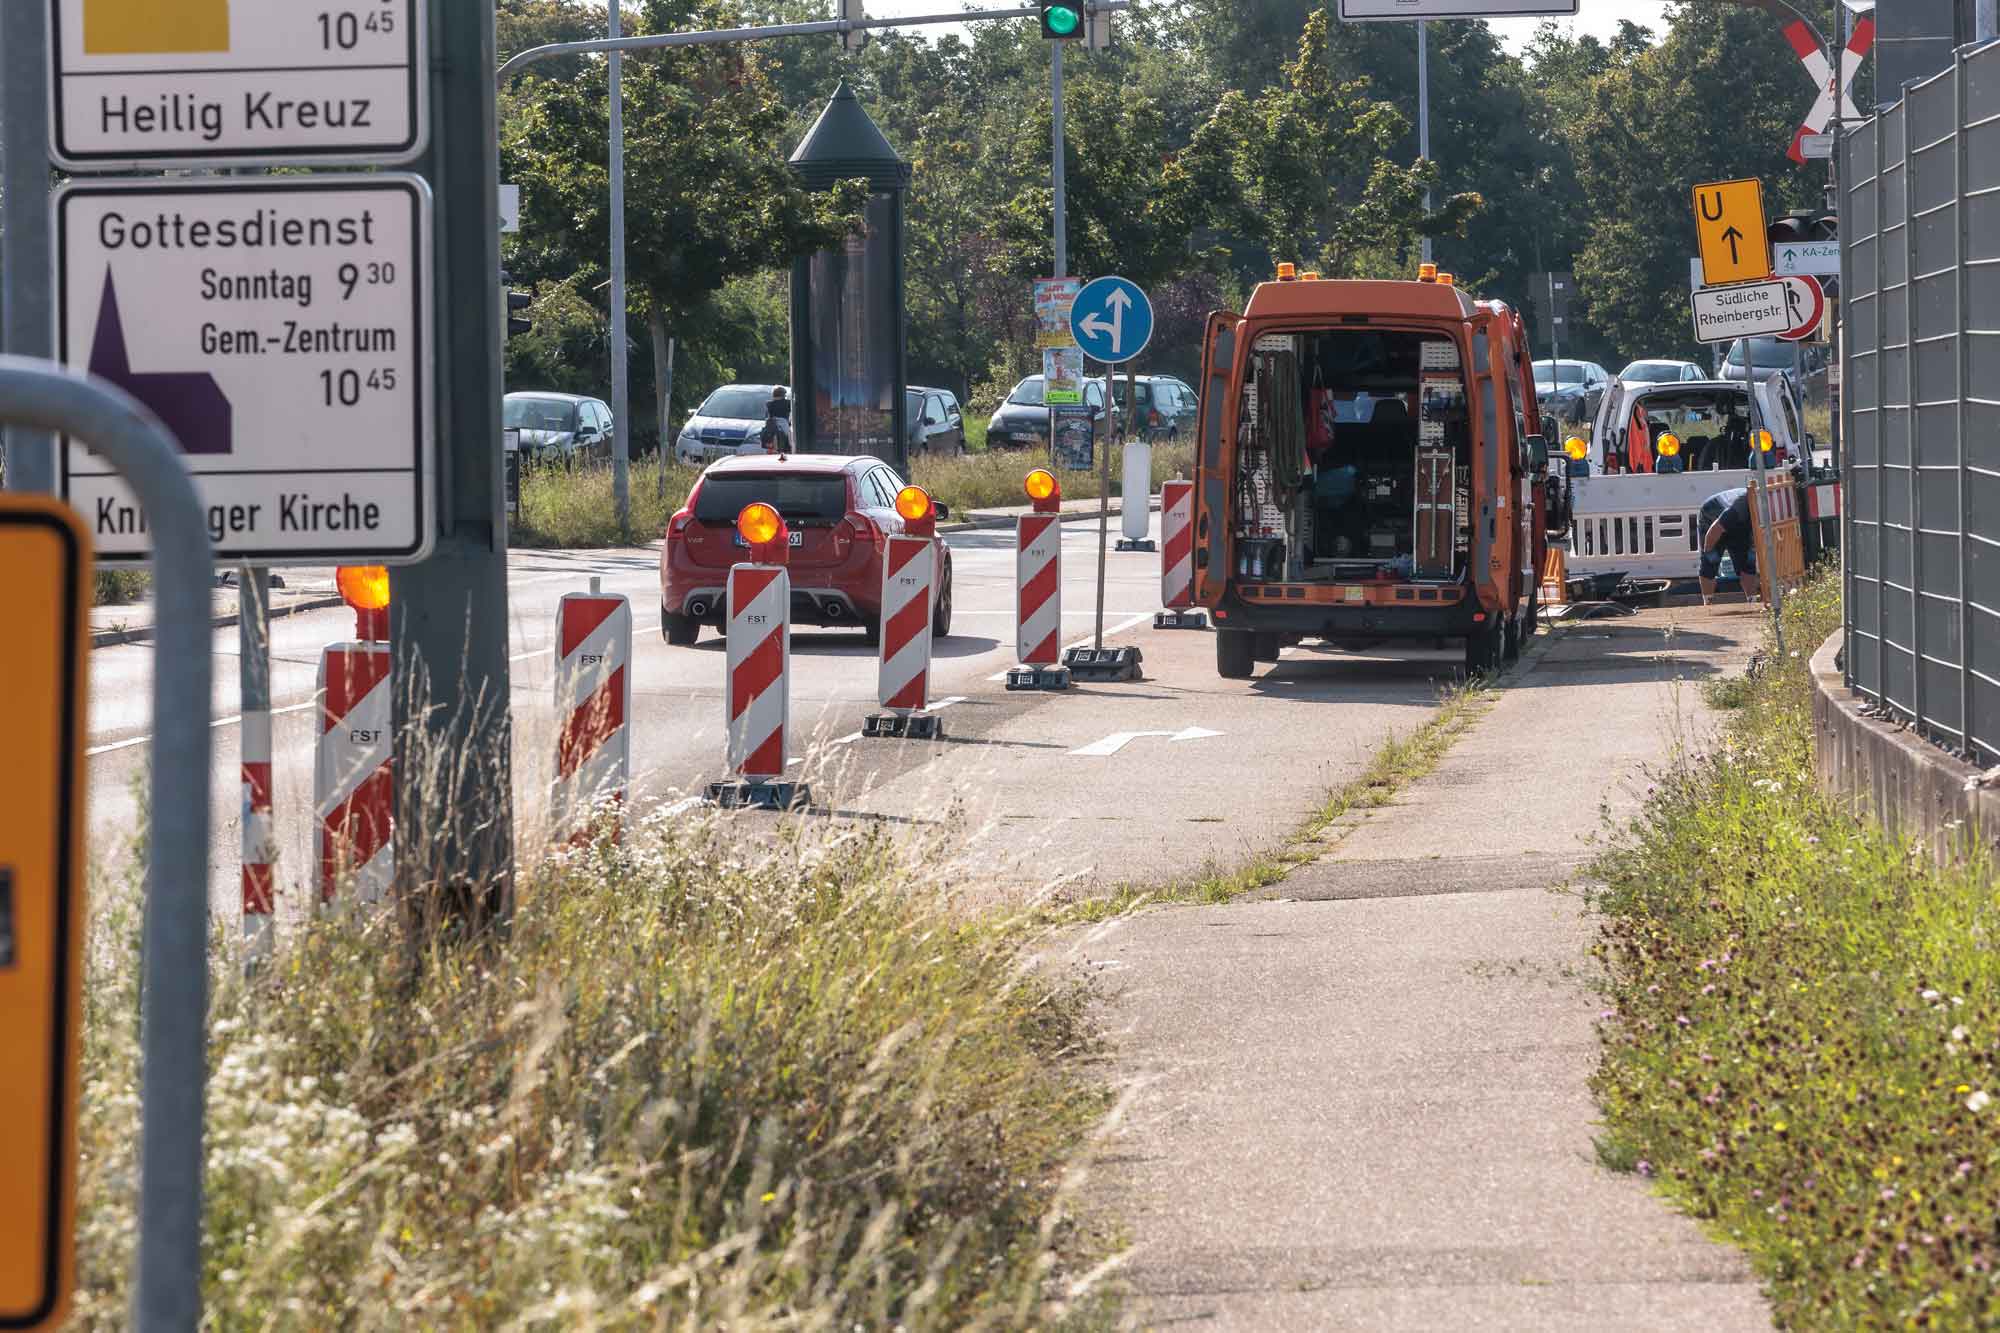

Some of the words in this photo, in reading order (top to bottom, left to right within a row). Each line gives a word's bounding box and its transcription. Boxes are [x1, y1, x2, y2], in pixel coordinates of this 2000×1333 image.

[100, 93, 222, 141] Heilig
[245, 92, 372, 130] Kreuz
[1700, 191, 1723, 221] U
[99, 209, 375, 249] Gottesdienst
[200, 267, 312, 307] Sonntag
[1715, 289, 1769, 306] Südliche
[1700, 305, 1784, 326] Rheinbergstr.
[200, 321, 396, 355] Gem.-Zentrum
[279, 493, 380, 532] Kirche
[900, 577, 917, 585] FST
[747, 615, 768, 623] FST
[581, 655, 603, 665] FST
[350, 729, 382, 743] FST
